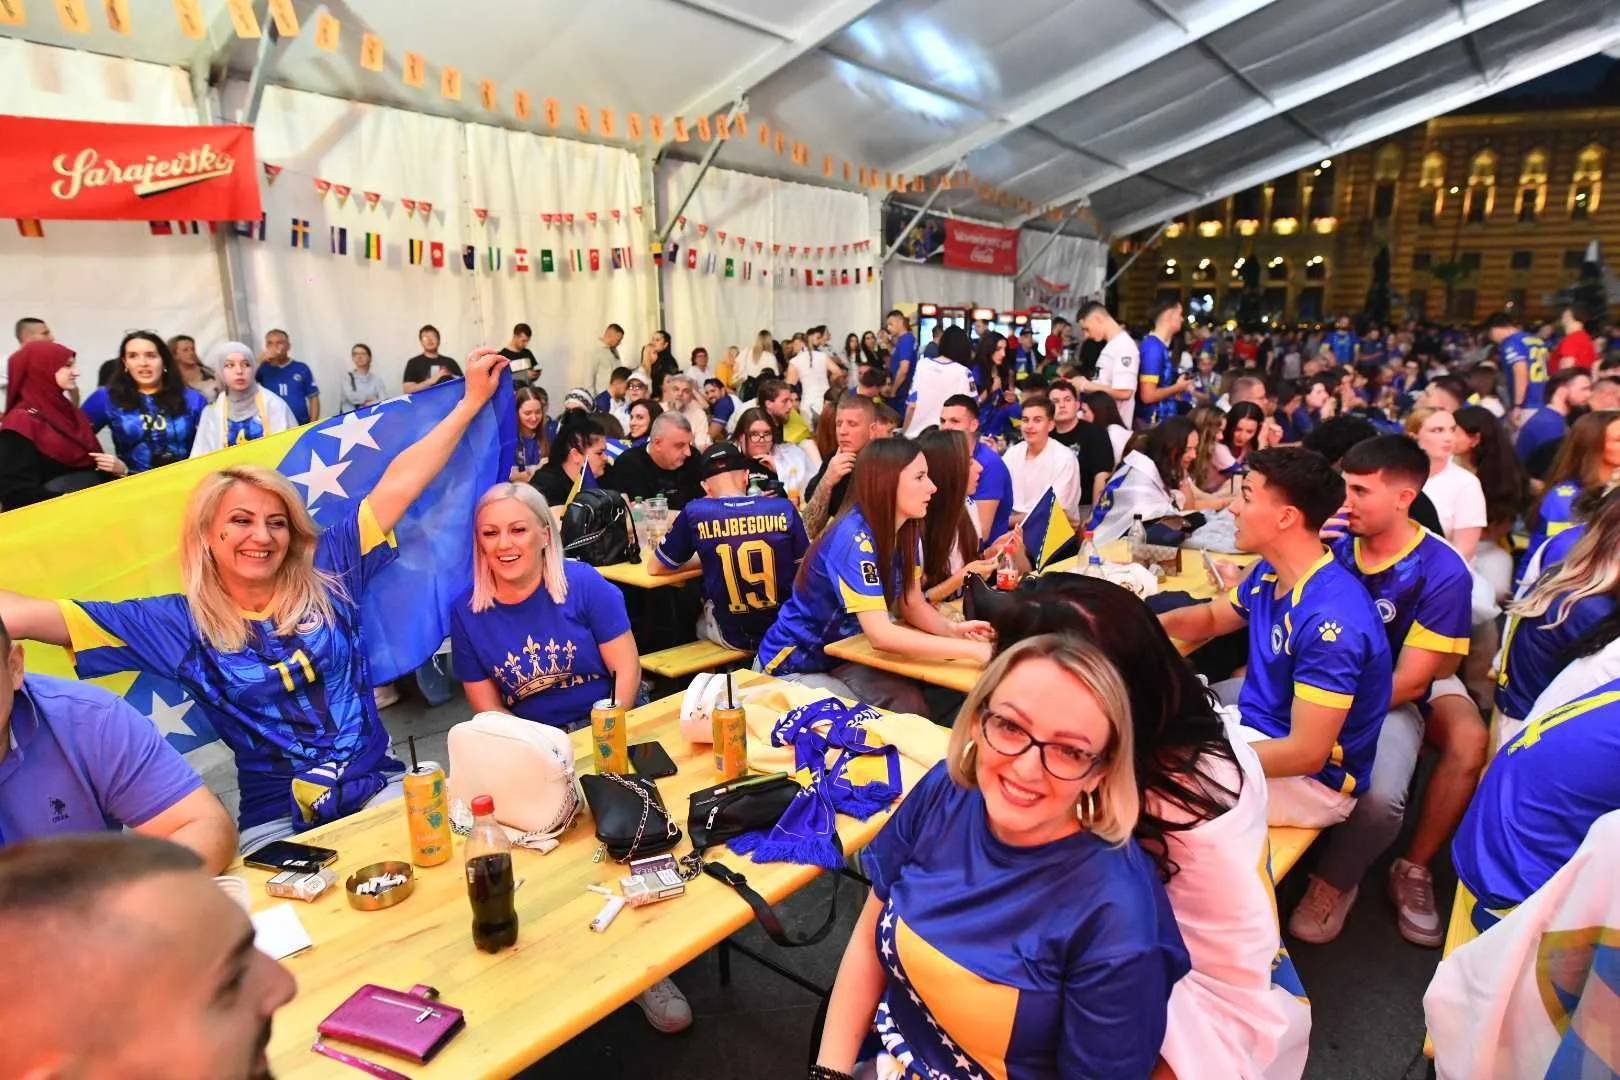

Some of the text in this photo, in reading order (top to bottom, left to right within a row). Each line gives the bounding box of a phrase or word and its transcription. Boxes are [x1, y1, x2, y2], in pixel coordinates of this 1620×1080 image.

[697, 512, 788, 539] ALAJBEGOVIĆ
[715, 540, 778, 613] 19
[269, 649, 316, 692] 11
